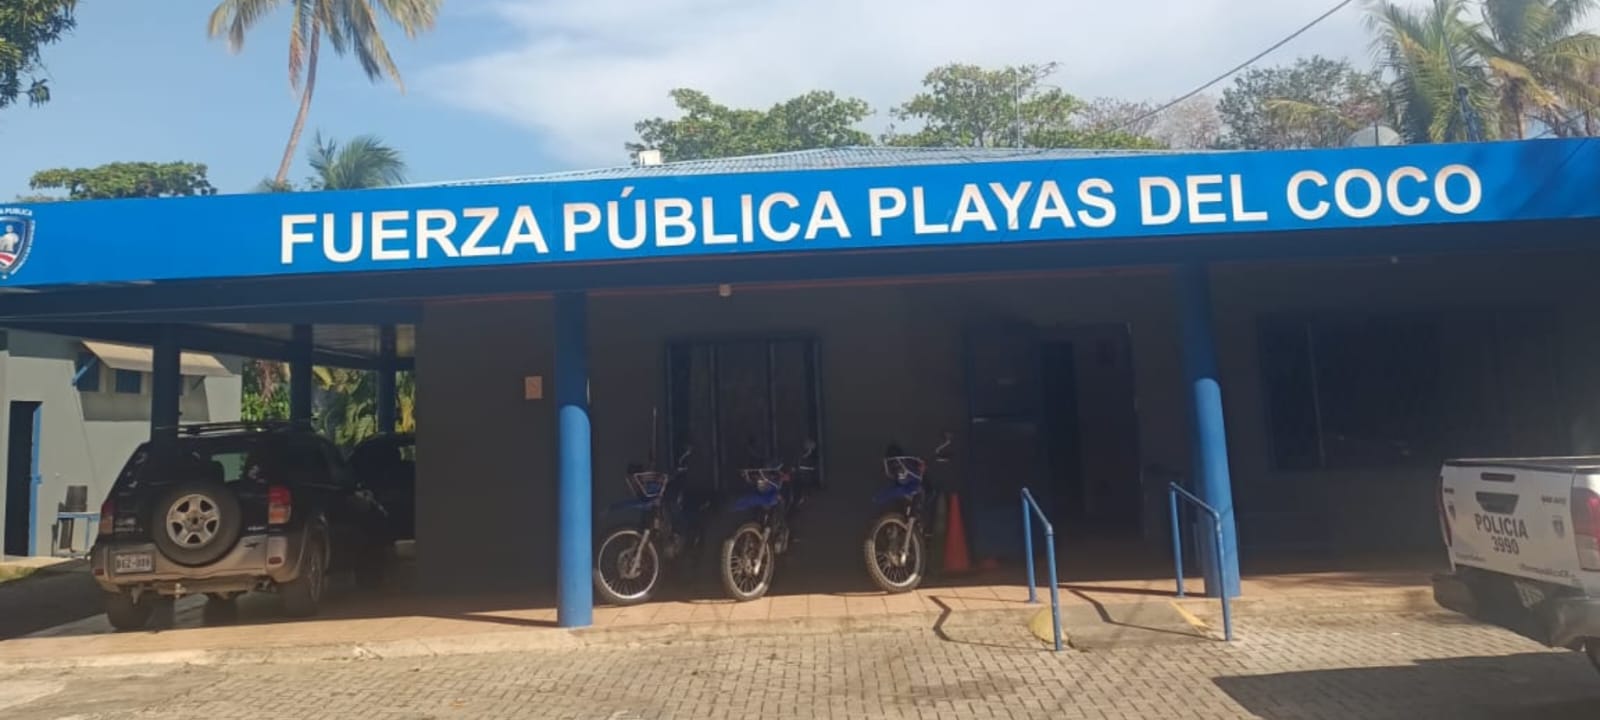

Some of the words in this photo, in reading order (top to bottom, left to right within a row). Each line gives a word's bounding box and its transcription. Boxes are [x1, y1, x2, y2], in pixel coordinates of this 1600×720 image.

[281, 205, 549, 264] FUERZA
[563, 186, 851, 252] PÚBLICA
[869, 178, 1116, 237] PLAYAS
[1139, 174, 1268, 225] DEL
[1286, 164, 1482, 220] COCO
[1475, 514, 1528, 539] POLICIA
[1491, 537, 1520, 554] 3990
